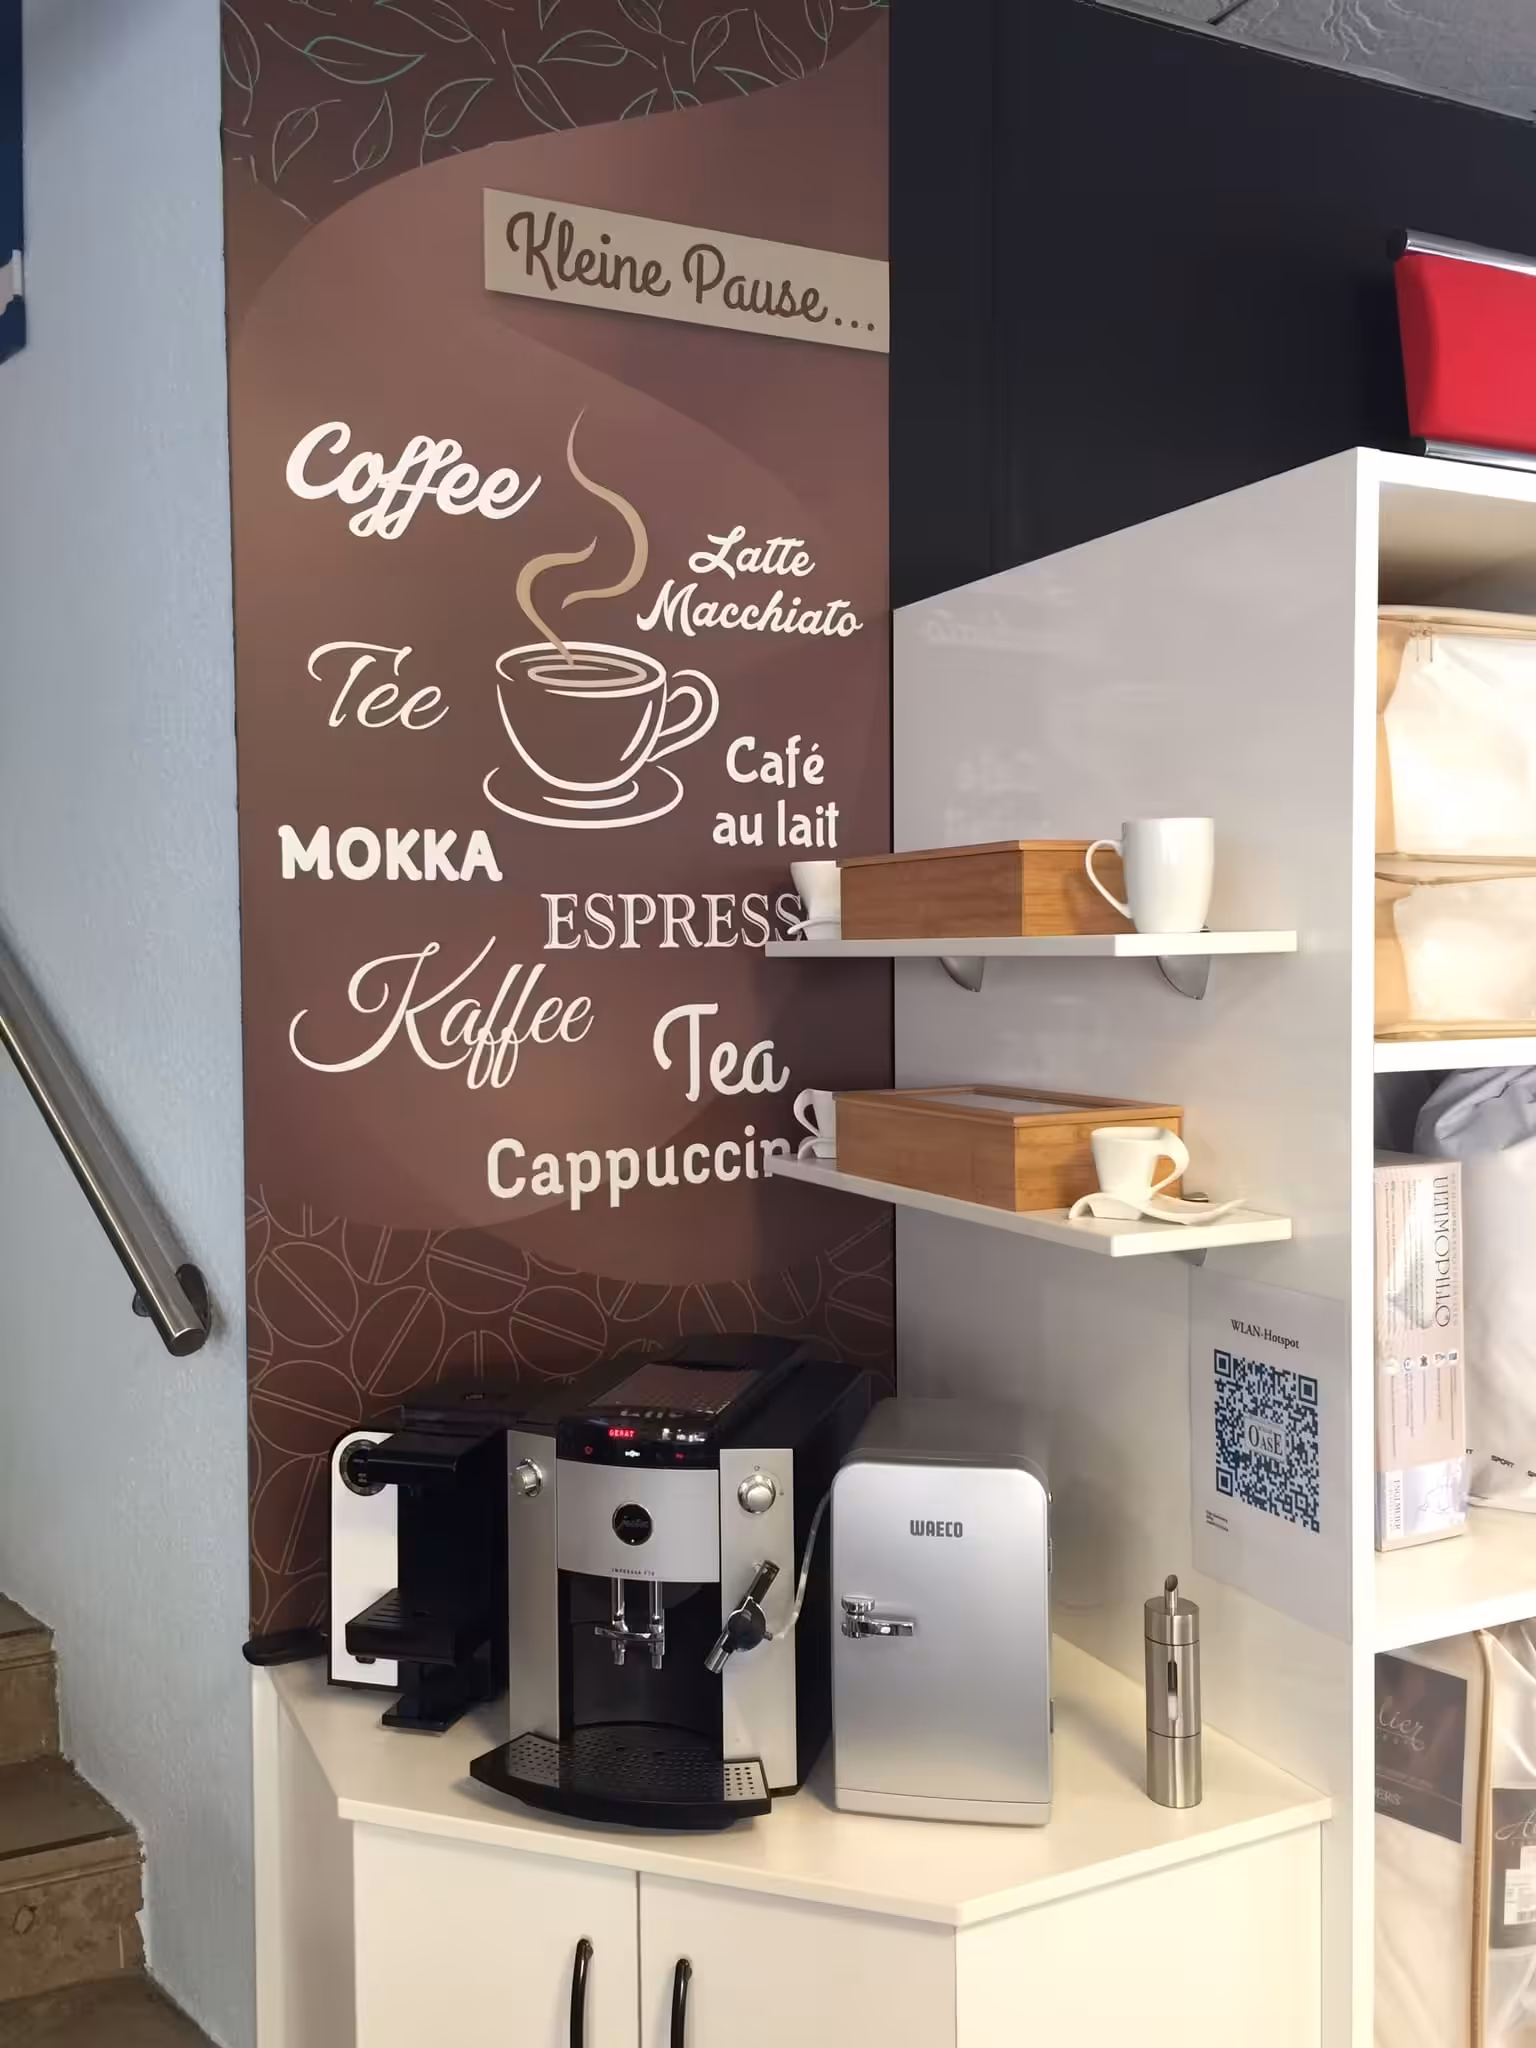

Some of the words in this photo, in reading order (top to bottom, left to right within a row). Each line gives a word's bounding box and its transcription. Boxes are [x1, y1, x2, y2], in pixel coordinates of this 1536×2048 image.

[506, 211, 671, 297] Kleine
[683, 243, 875, 332] Pause...
[286, 422, 541, 539] Coffee
[689, 526, 815, 579] Latte
[637, 580, 864, 637] Macchiato
[308, 642, 449, 729] Tee
[726, 735, 825, 789] Café
[712, 812, 763, 847] au
[777, 799, 840, 848] lait
[278, 825, 503, 882] MOKKA
[540, 892, 806, 950] ESPRESS
[289, 936, 595, 1090] Kaffee
[652, 1002, 790, 1102] Tea
[487, 1125, 791, 1211] Cappuccin
[1432, 1176, 1451, 1328] ULTIMOPILLO
[1230, 1318, 1300, 1350] WLAN-Hotspot
[909, 1519, 964, 1538] WAECO
